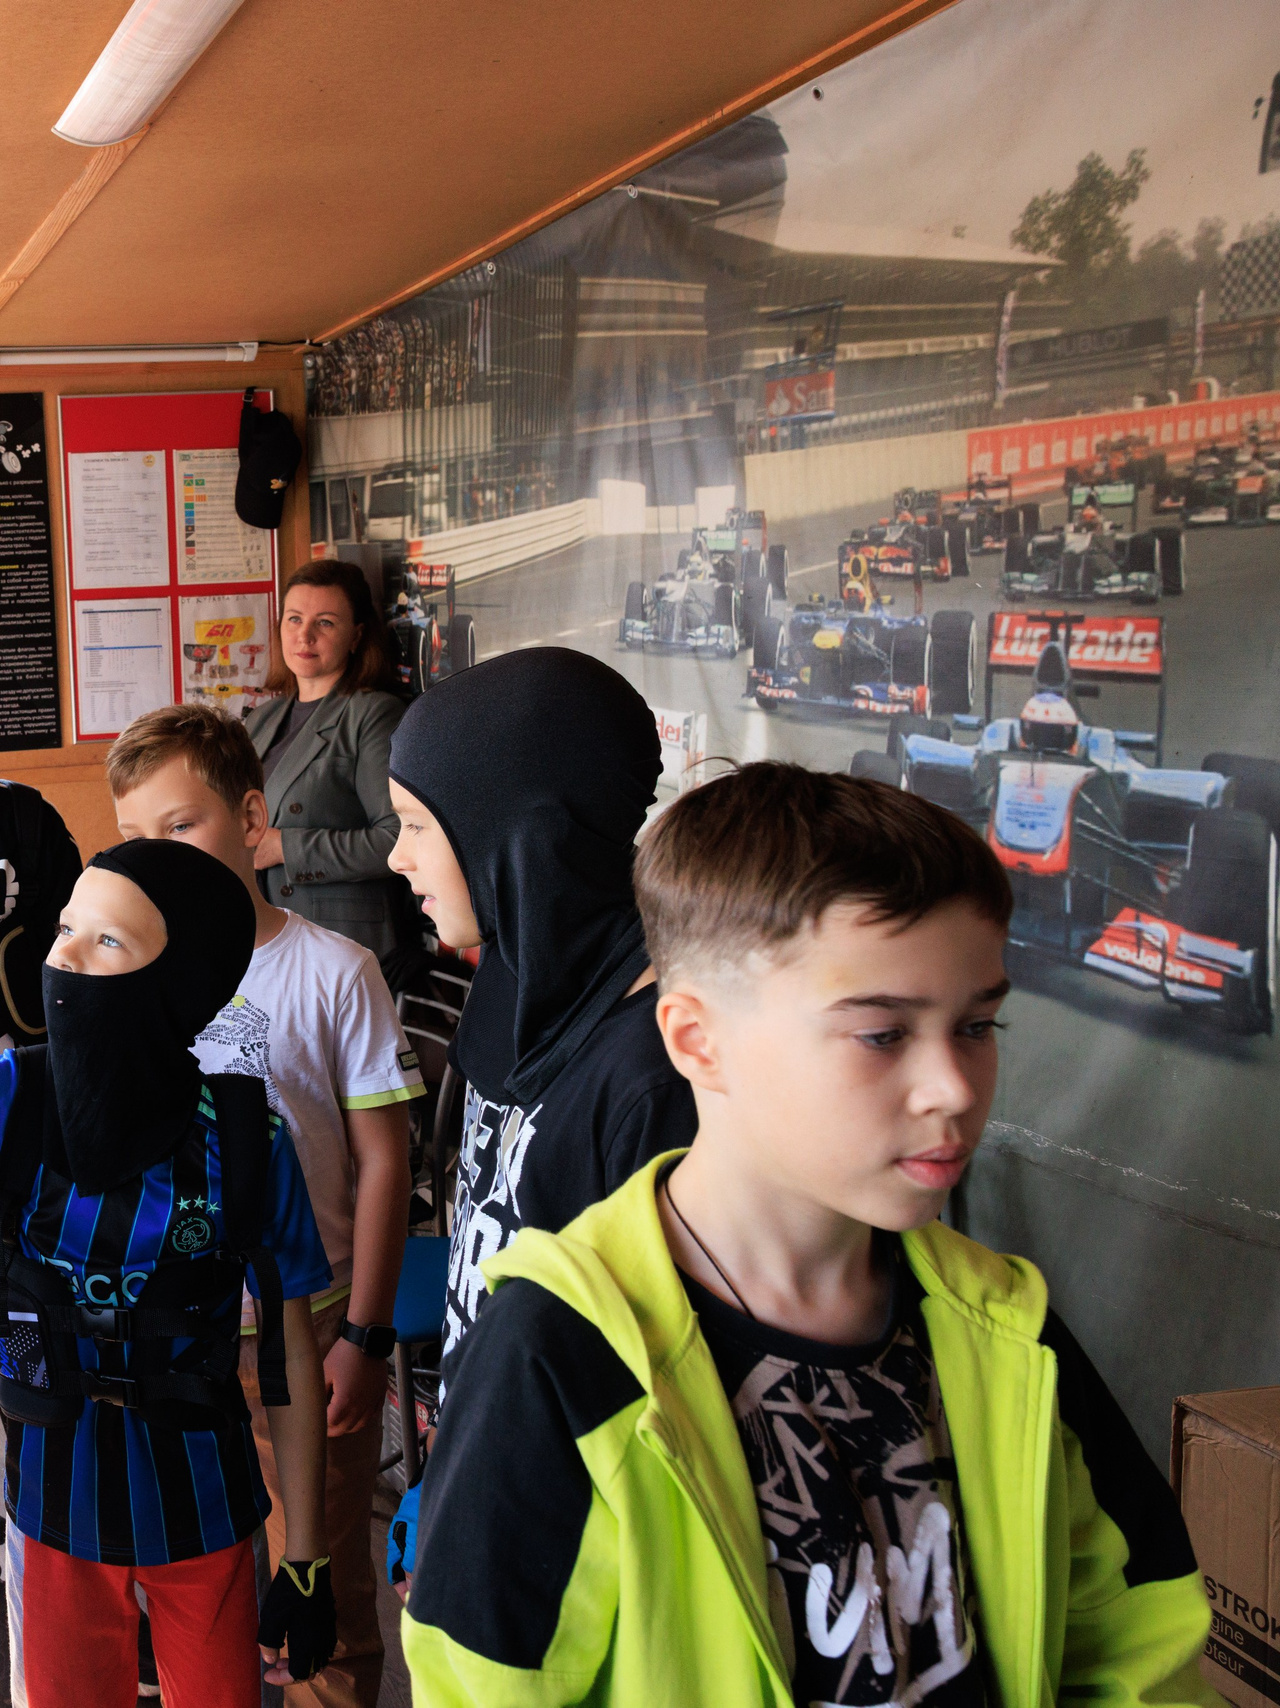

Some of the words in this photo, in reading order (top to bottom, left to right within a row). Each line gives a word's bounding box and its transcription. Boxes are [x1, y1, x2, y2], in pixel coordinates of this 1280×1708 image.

[239, 1039, 268, 1058] t-rex
[1210, 1616, 1244, 1646] gine
[1205, 1640, 1245, 1676] oteur
